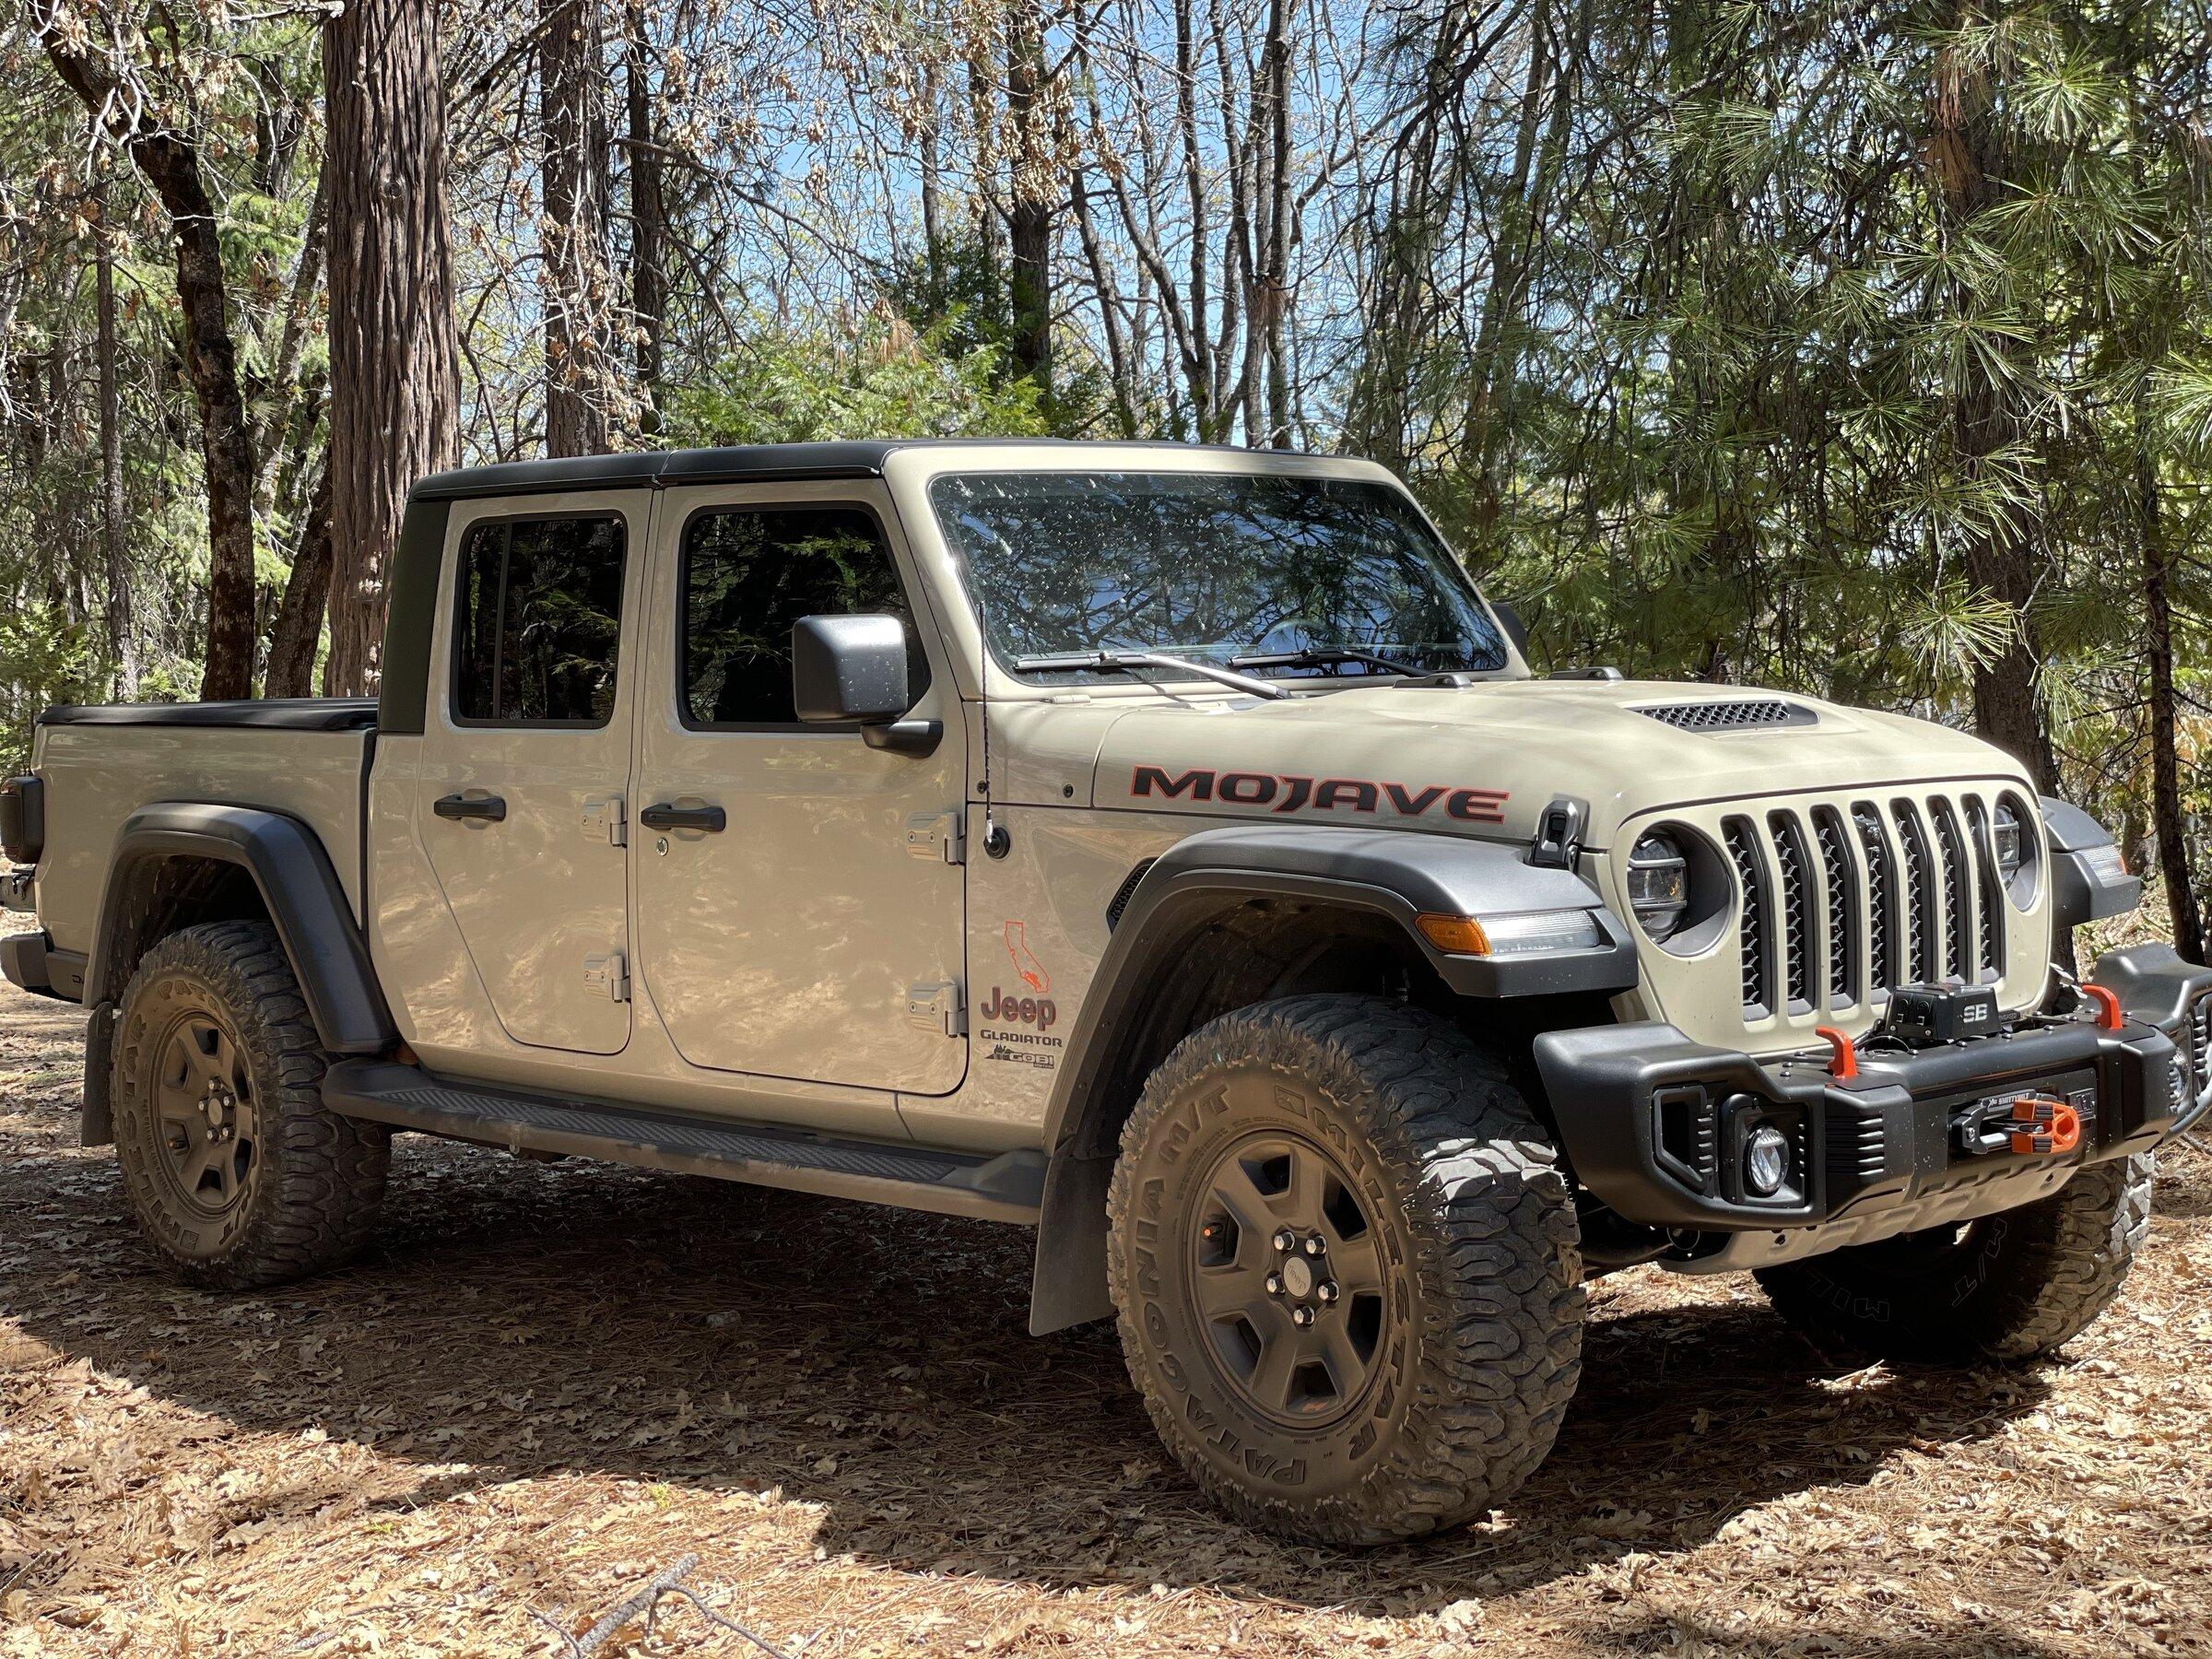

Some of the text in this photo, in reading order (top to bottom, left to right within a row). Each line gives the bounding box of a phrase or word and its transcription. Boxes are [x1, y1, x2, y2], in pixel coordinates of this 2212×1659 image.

[1130, 764, 1510, 824] MOJAVE
[980, 985, 1057, 1031] Jeep
[980, 1029, 1063, 1048] GLADIATOR
[1008, 1051, 1054, 1065] GOBI
[1158, 1083, 1231, 1165] M/T
[1313, 1107, 1411, 1461] MILESTAR
[1135, 1178, 1307, 1486] PATAGONIA
